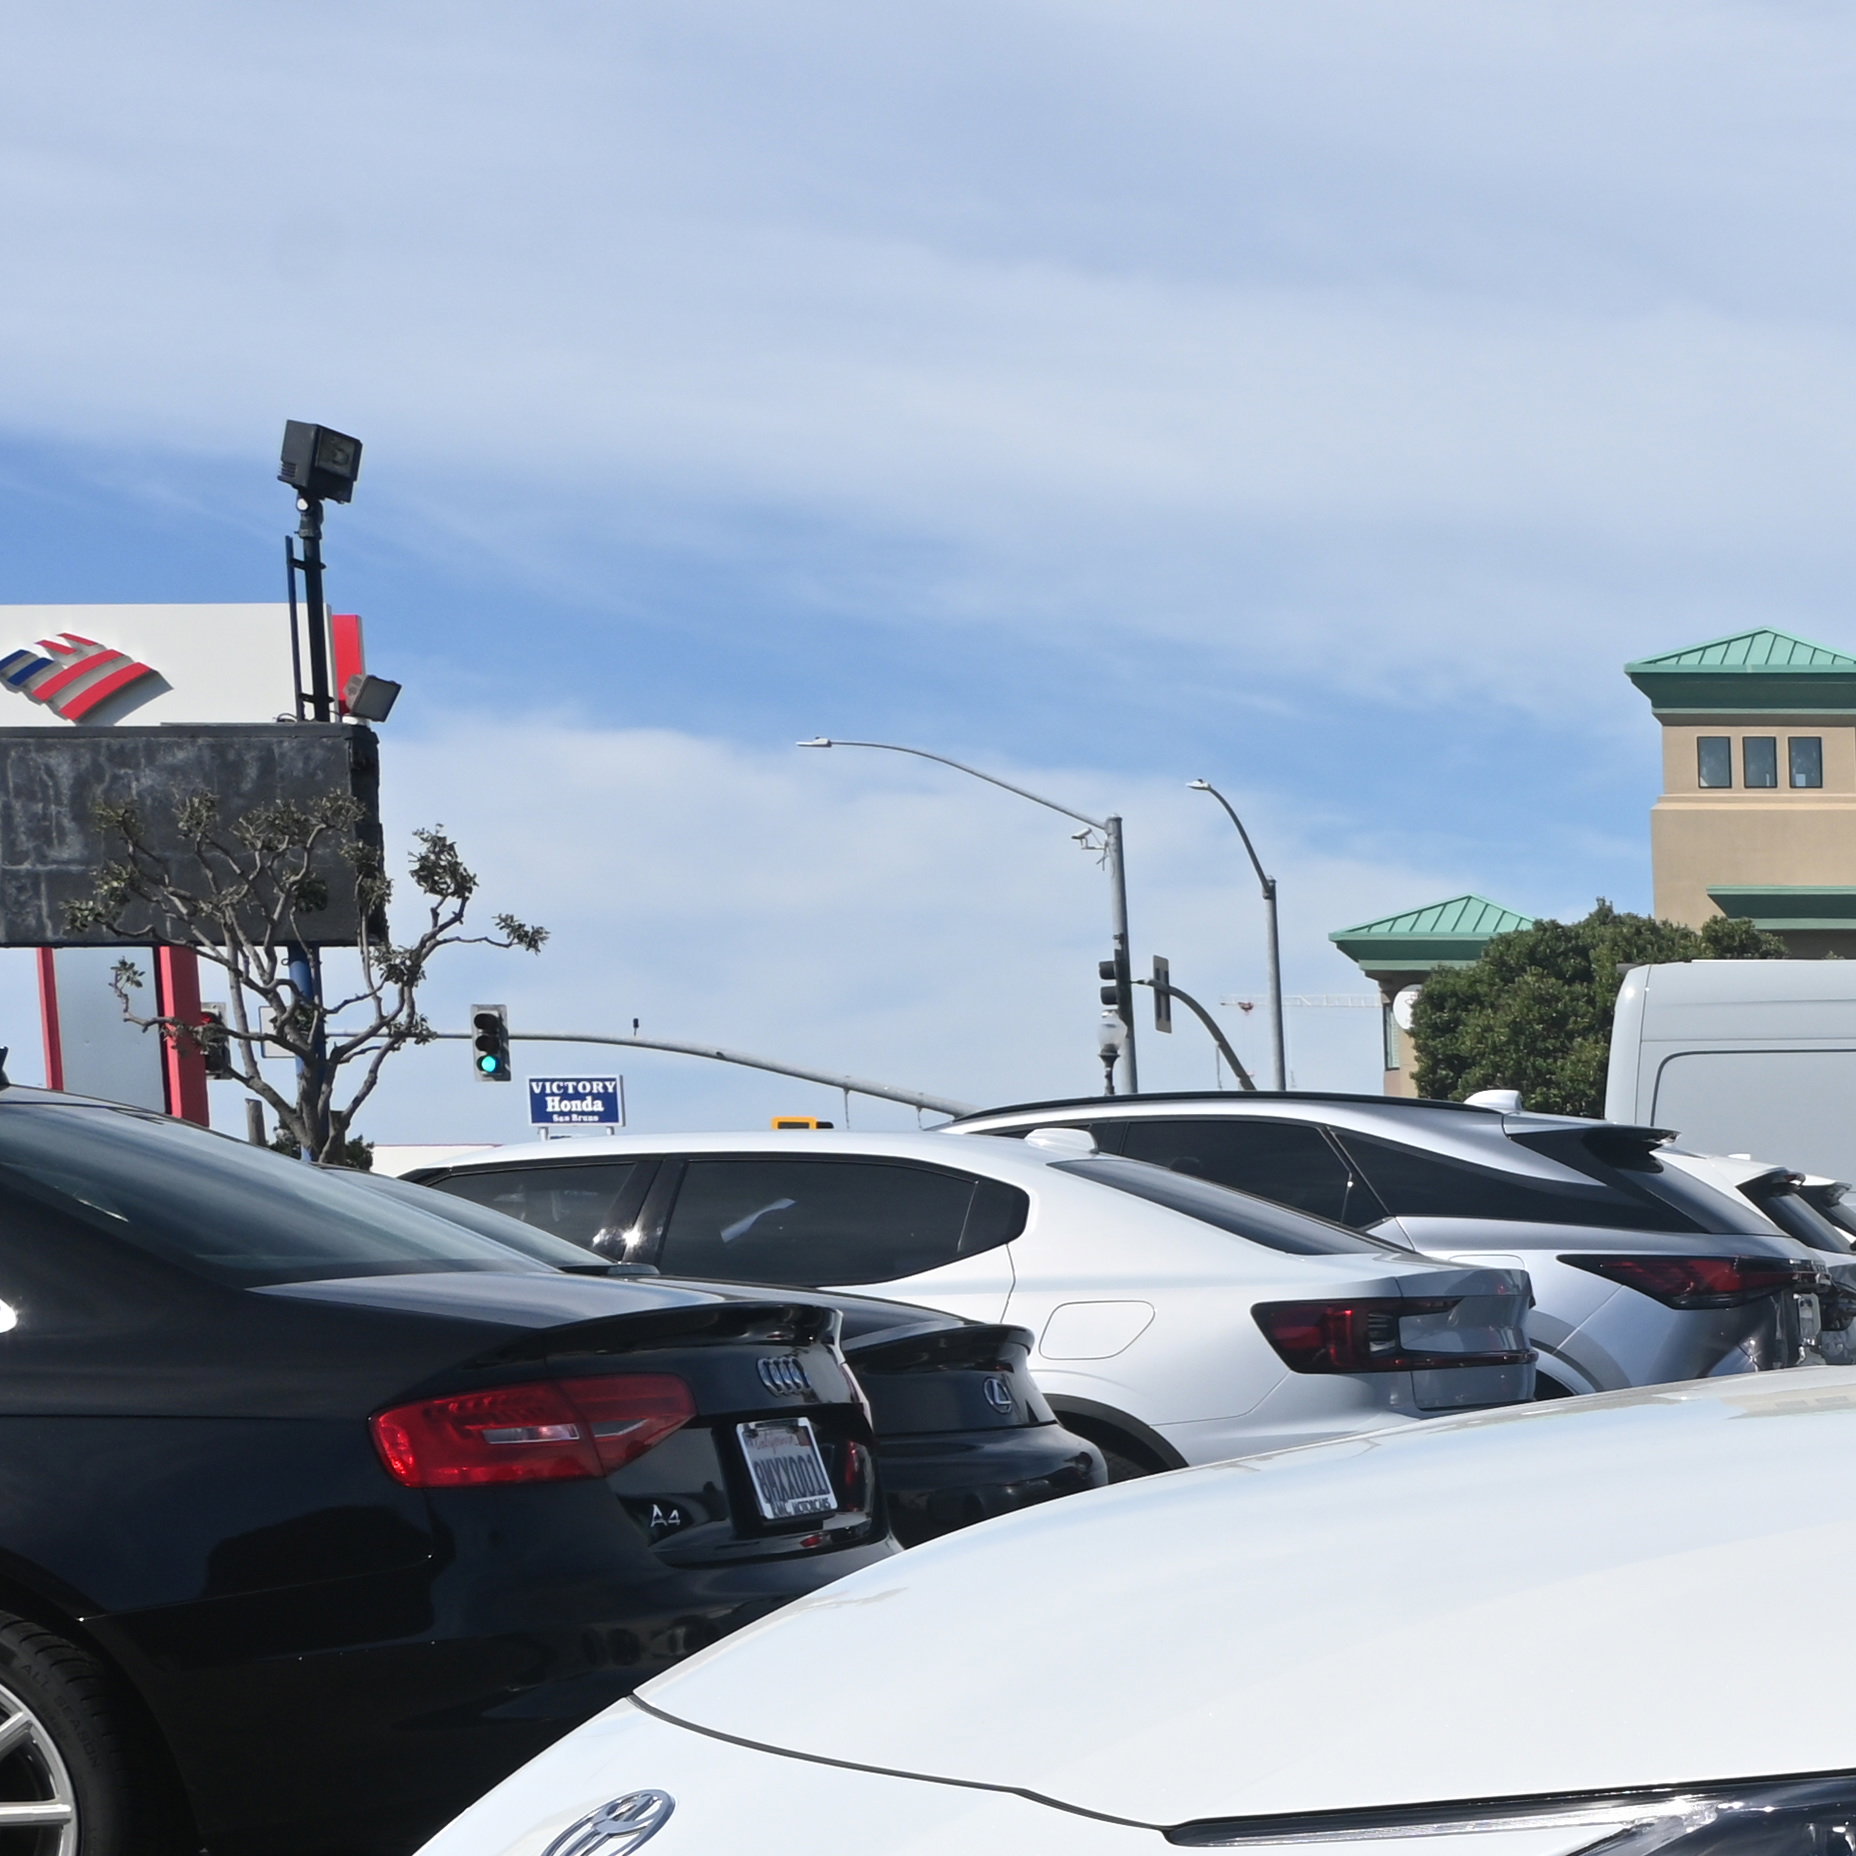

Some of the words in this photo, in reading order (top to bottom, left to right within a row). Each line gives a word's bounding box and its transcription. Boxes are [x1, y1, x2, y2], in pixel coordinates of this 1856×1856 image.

[531, 1081, 616, 1094] VICTORY
[545, 1096, 604, 1112] Honda
[552, 1114, 570, 1122] San
[650, 1504, 681, 1527] A4
